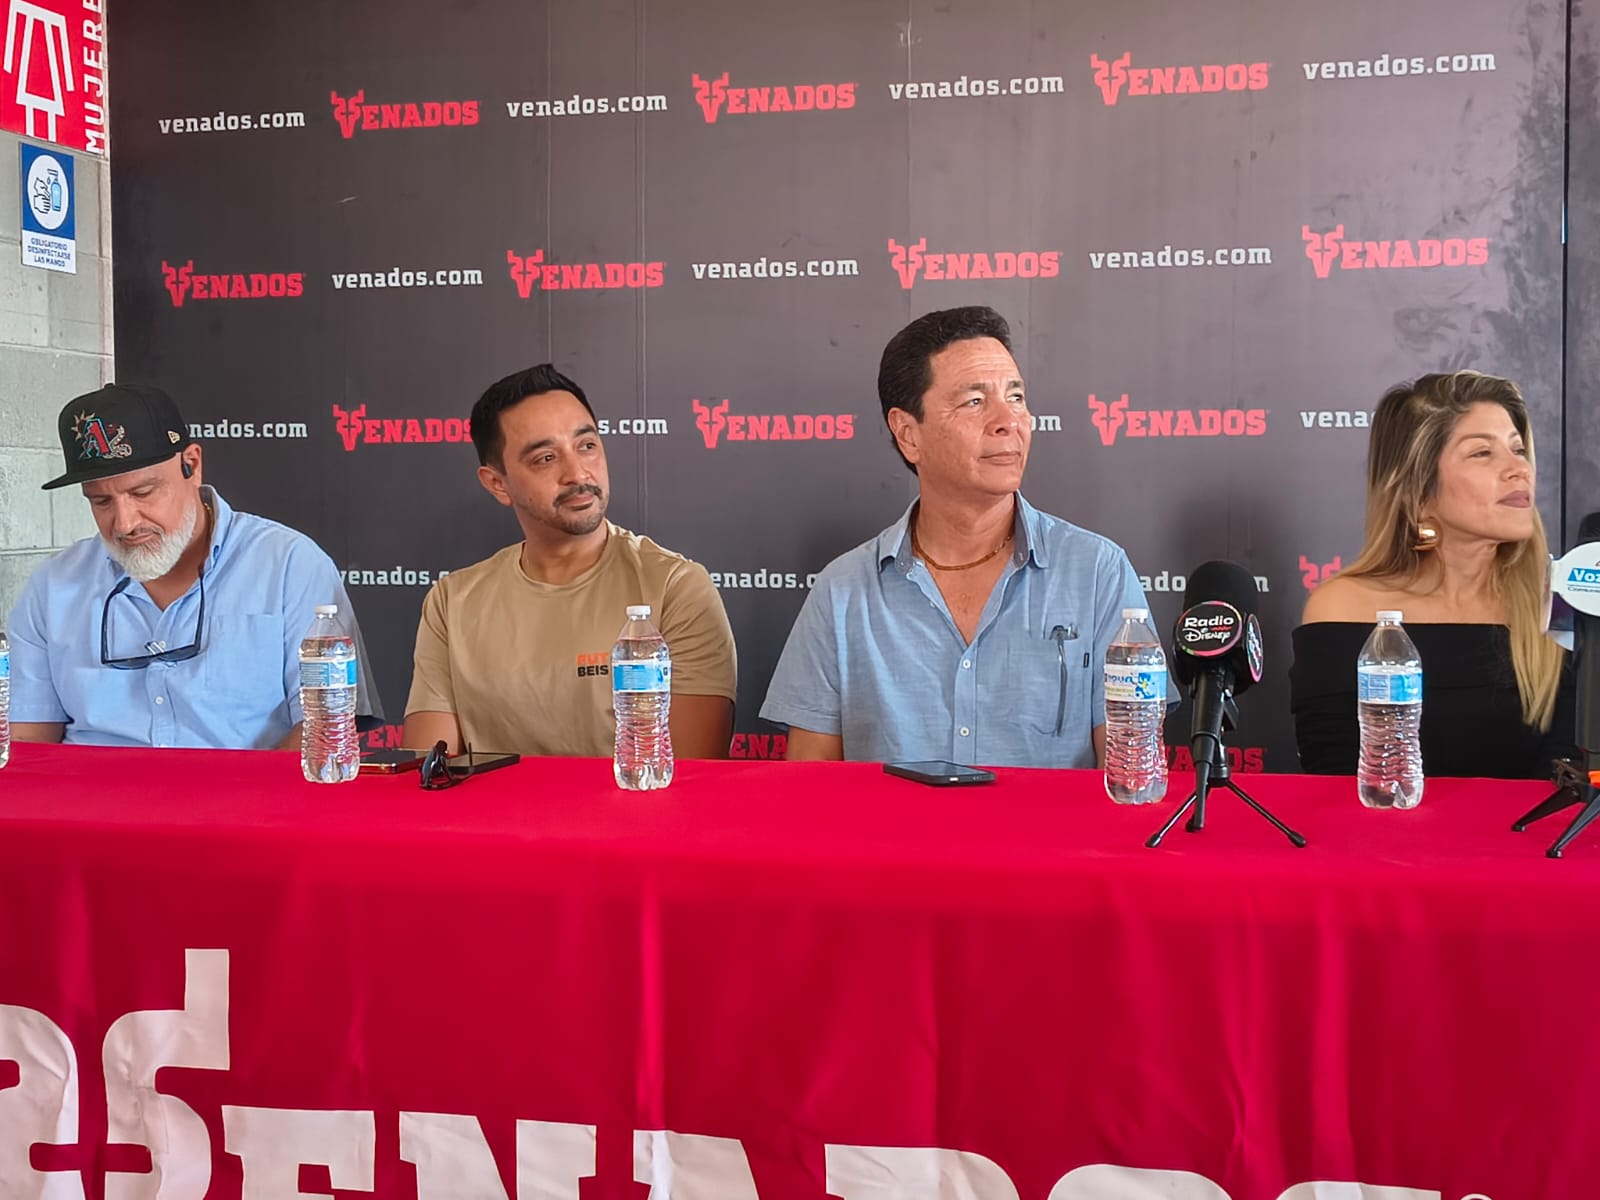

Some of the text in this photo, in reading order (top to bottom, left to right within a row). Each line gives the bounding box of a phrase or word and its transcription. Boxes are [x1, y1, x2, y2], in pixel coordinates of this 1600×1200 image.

[1304, 54, 1495, 79] venados.com
[889, 76, 1063, 99] venados.com
[507, 95, 667, 117] venados.com
[159, 112, 305, 133] venados.com
[1090, 246, 1271, 268] venados.com
[332, 268, 483, 288] venados.com
[692, 258, 858, 279] venados.com
[188, 419, 307, 437] nados.com
[1184, 616, 1235, 627] Radio
[577, 665, 609, 677] BEIS
